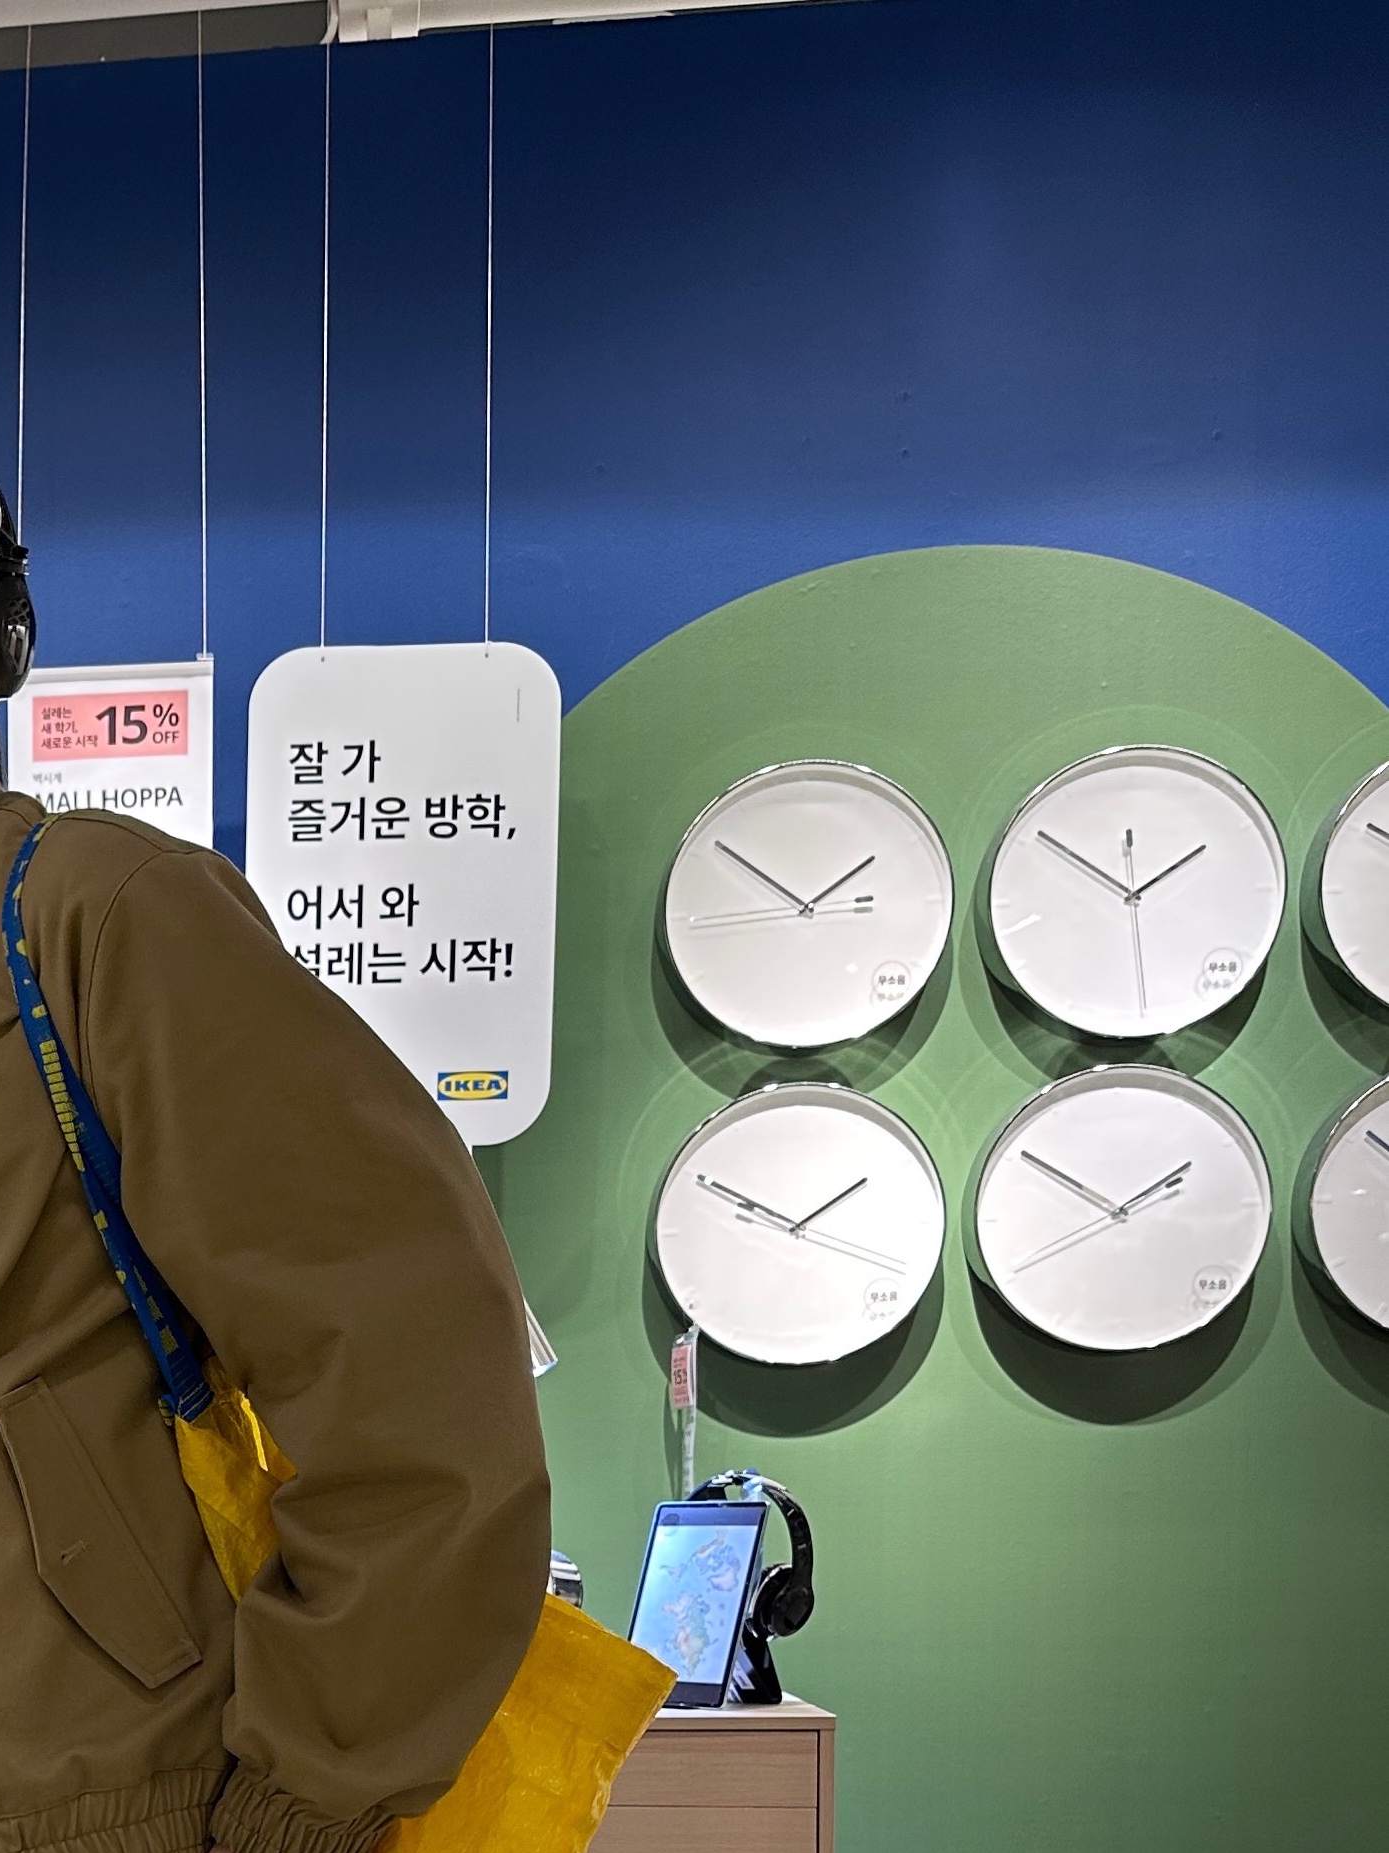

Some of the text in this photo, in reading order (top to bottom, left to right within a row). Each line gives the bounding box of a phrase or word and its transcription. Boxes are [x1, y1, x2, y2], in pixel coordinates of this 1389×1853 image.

[41, 706, 72, 720] 설레는
[41, 722, 52, 734] 새
[41, 735, 99, 750] 새로운 시작
[152, 731, 180, 744] OFF
[289, 739, 381, 785] 잘 가
[288, 793, 516, 842] 즐거운 방학,
[287, 883, 420, 930] 어서 와
[419, 937, 514, 984] 시작!
[877, 974, 906, 987] 무소음
[444, 1079, 502, 1092] IKEA
